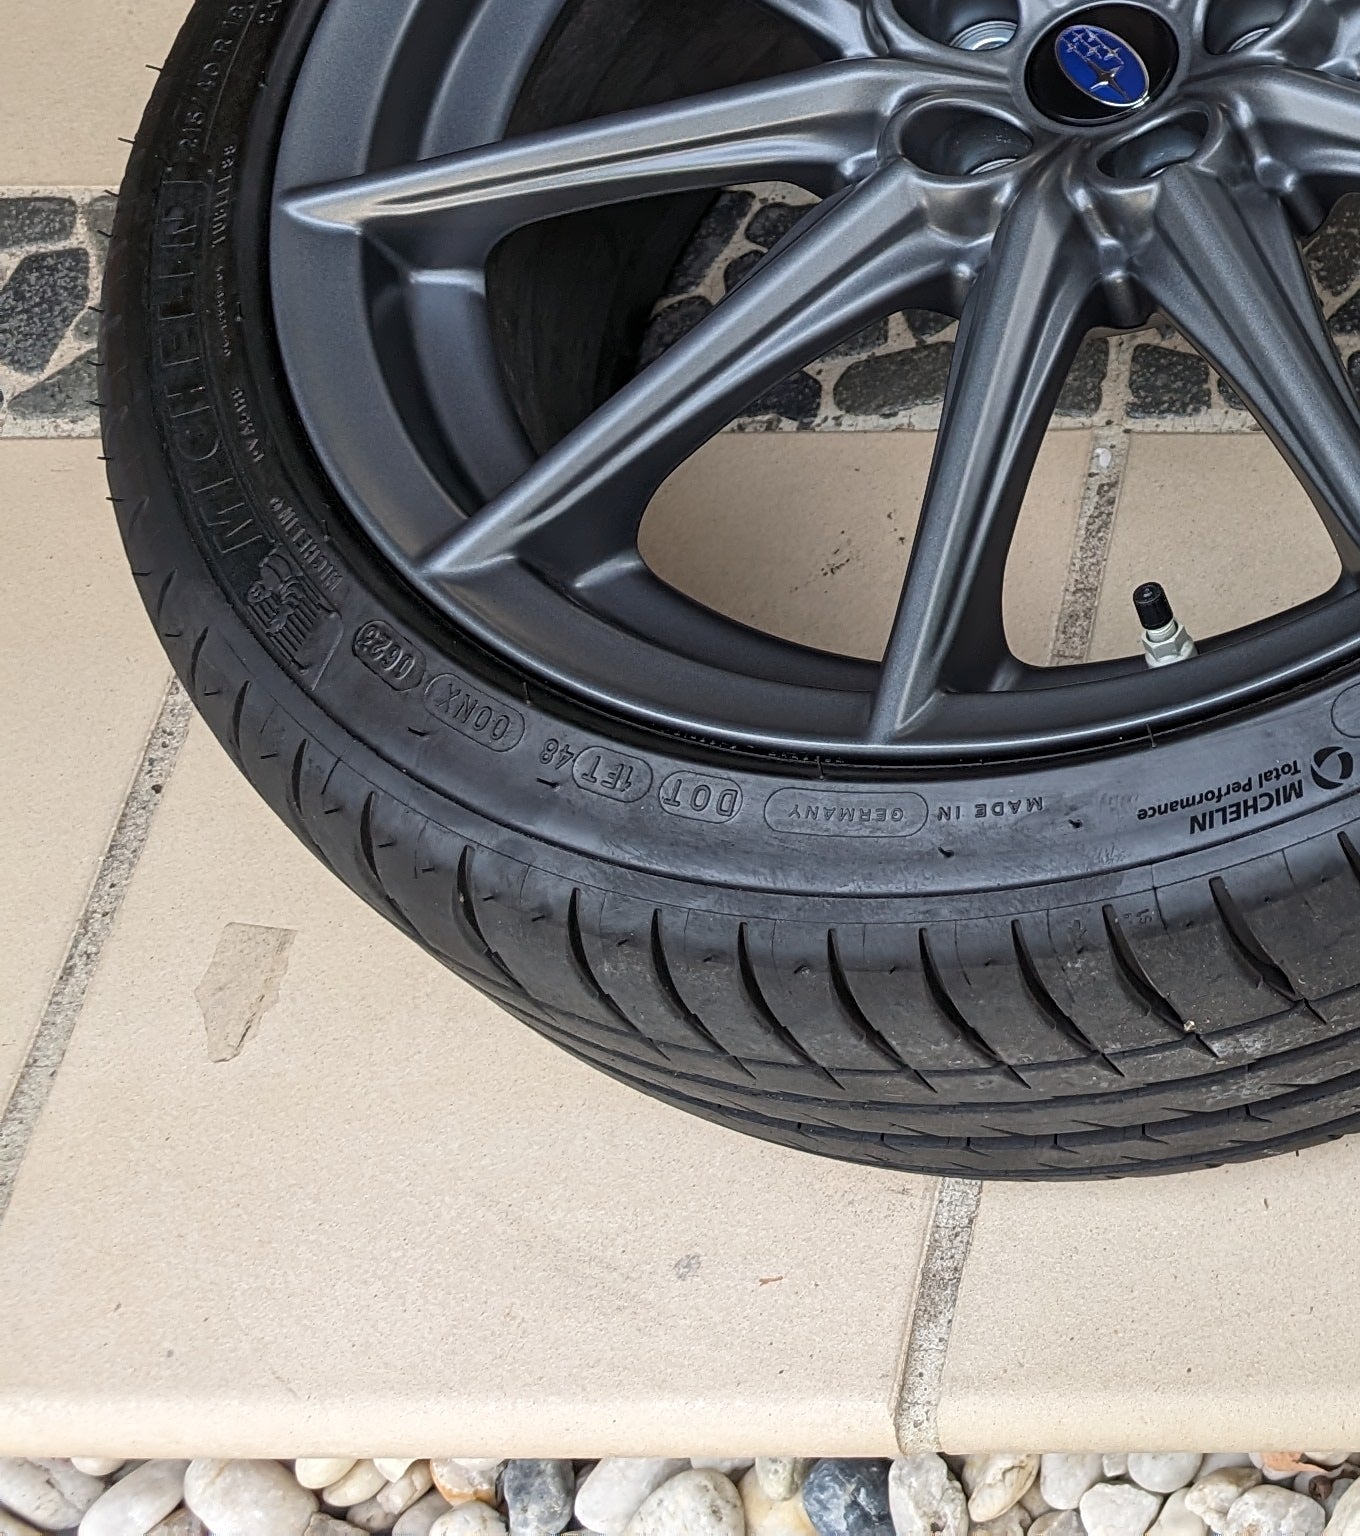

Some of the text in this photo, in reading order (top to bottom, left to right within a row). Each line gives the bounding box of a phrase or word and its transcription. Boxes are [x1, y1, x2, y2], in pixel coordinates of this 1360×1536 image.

[209, 38, 232, 53] R
[150, 174, 264, 556] MICHELIN
[532, 737, 740, 816] DOT 1FT 48
[1135, 758, 1301, 824] Total Performance
[1185, 777, 1308, 834] MICHELIN
[786, 795, 1042, 823] MADE IN GERMANY
